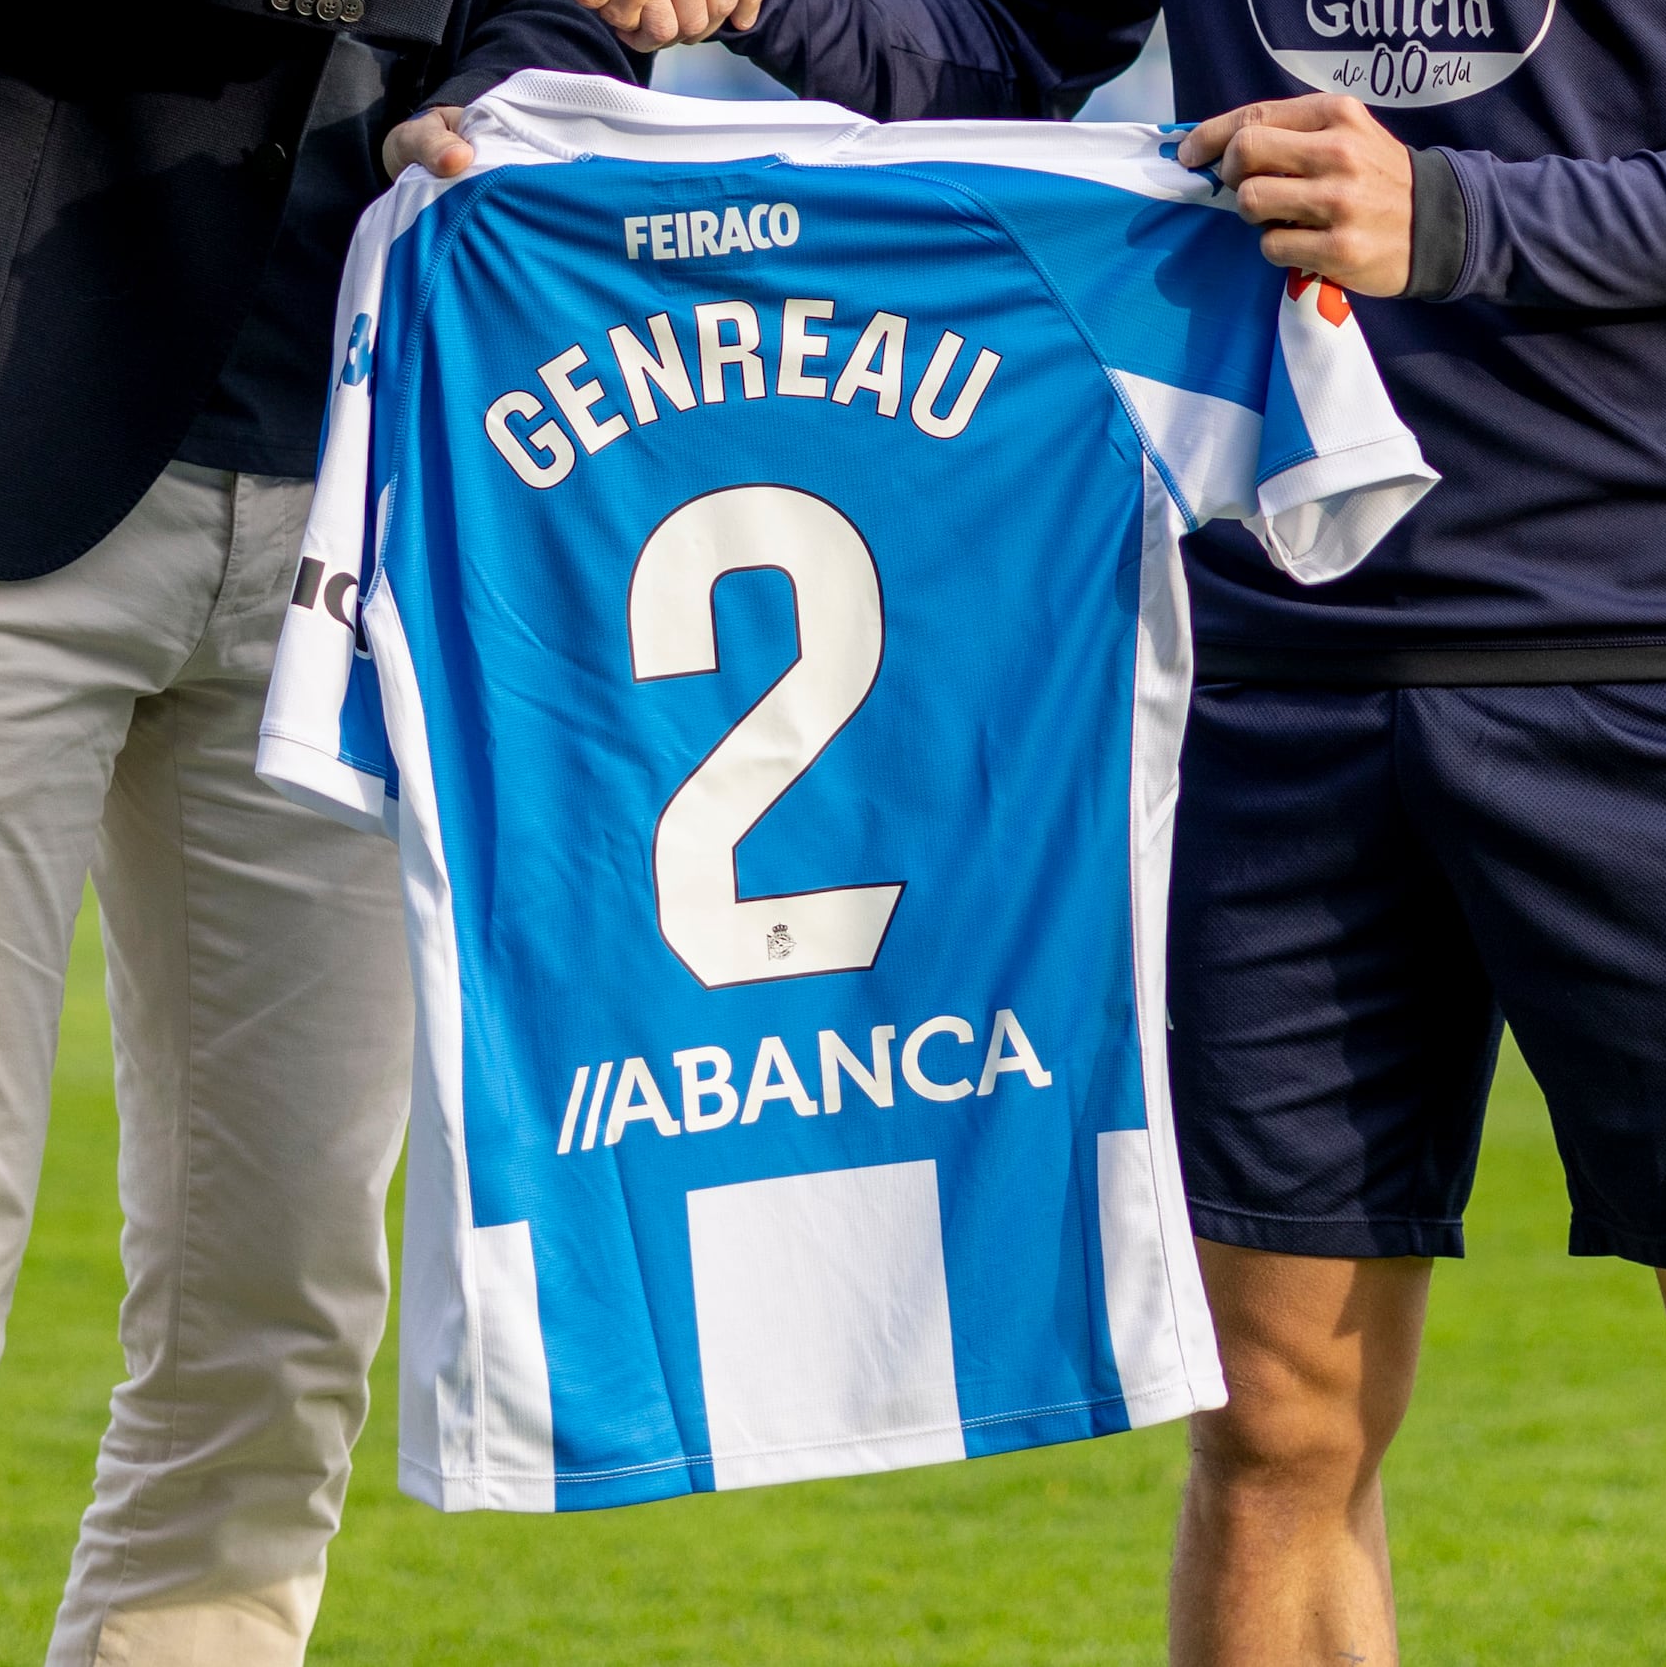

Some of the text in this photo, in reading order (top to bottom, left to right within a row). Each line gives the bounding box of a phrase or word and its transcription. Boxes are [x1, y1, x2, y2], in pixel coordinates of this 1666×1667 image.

[1332, 58, 1367, 88] alc.
[1369, 43, 1428, 99] 0,0
[624, 202, 800, 260] FEIRACO
[484, 297, 1003, 490] GENREAU
[627, 482, 907, 990] 2
